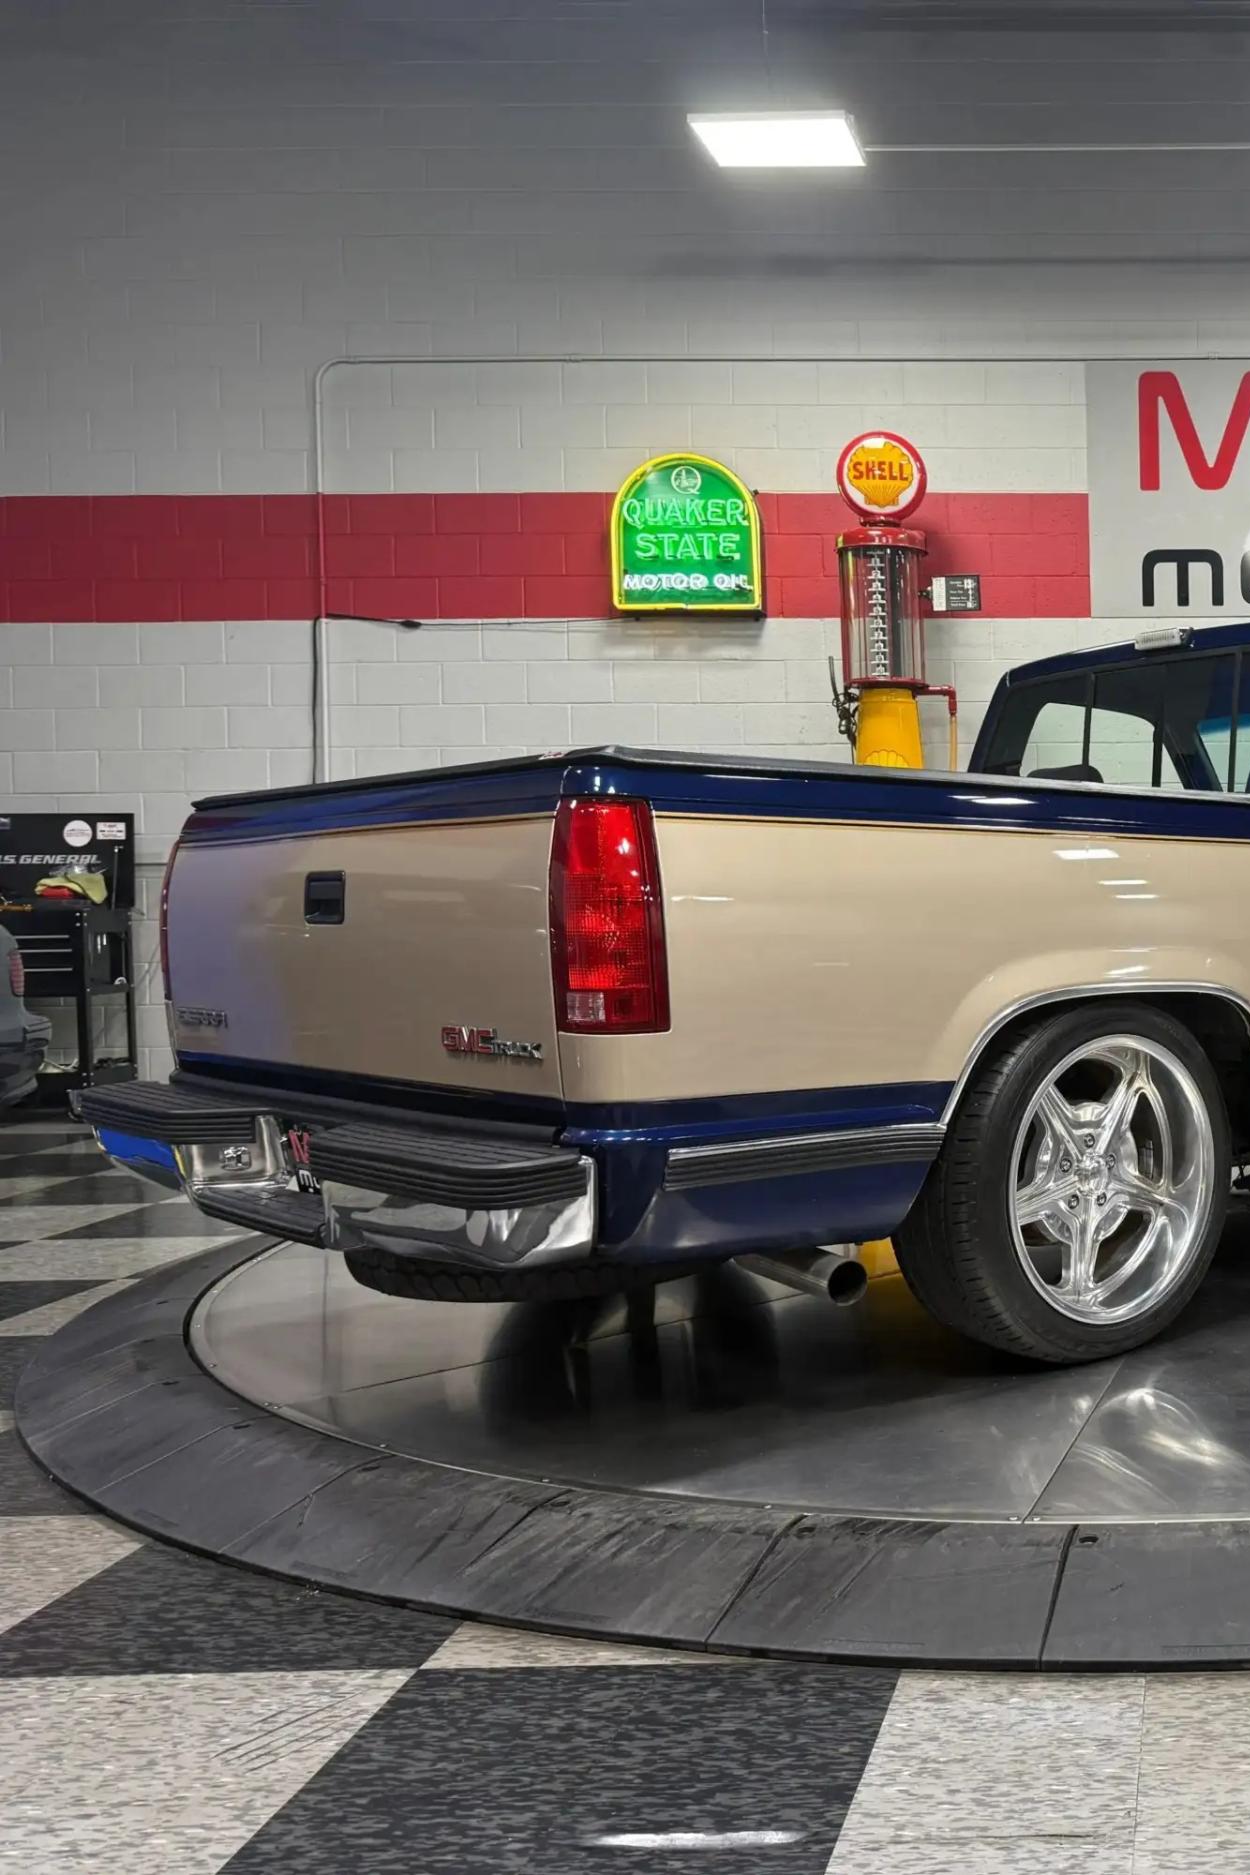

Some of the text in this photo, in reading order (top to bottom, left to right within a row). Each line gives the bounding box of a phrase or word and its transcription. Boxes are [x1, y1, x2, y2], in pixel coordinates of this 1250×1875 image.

[853, 461, 908, 481] SHELL
[622, 498, 749, 529] QUAKER
[634, 533, 741, 560] STATE
[623, 573, 754, 590] MOTOR OIL
[19, 855, 103, 865] GENERAL
[441, 1025, 495, 1055] GMC
